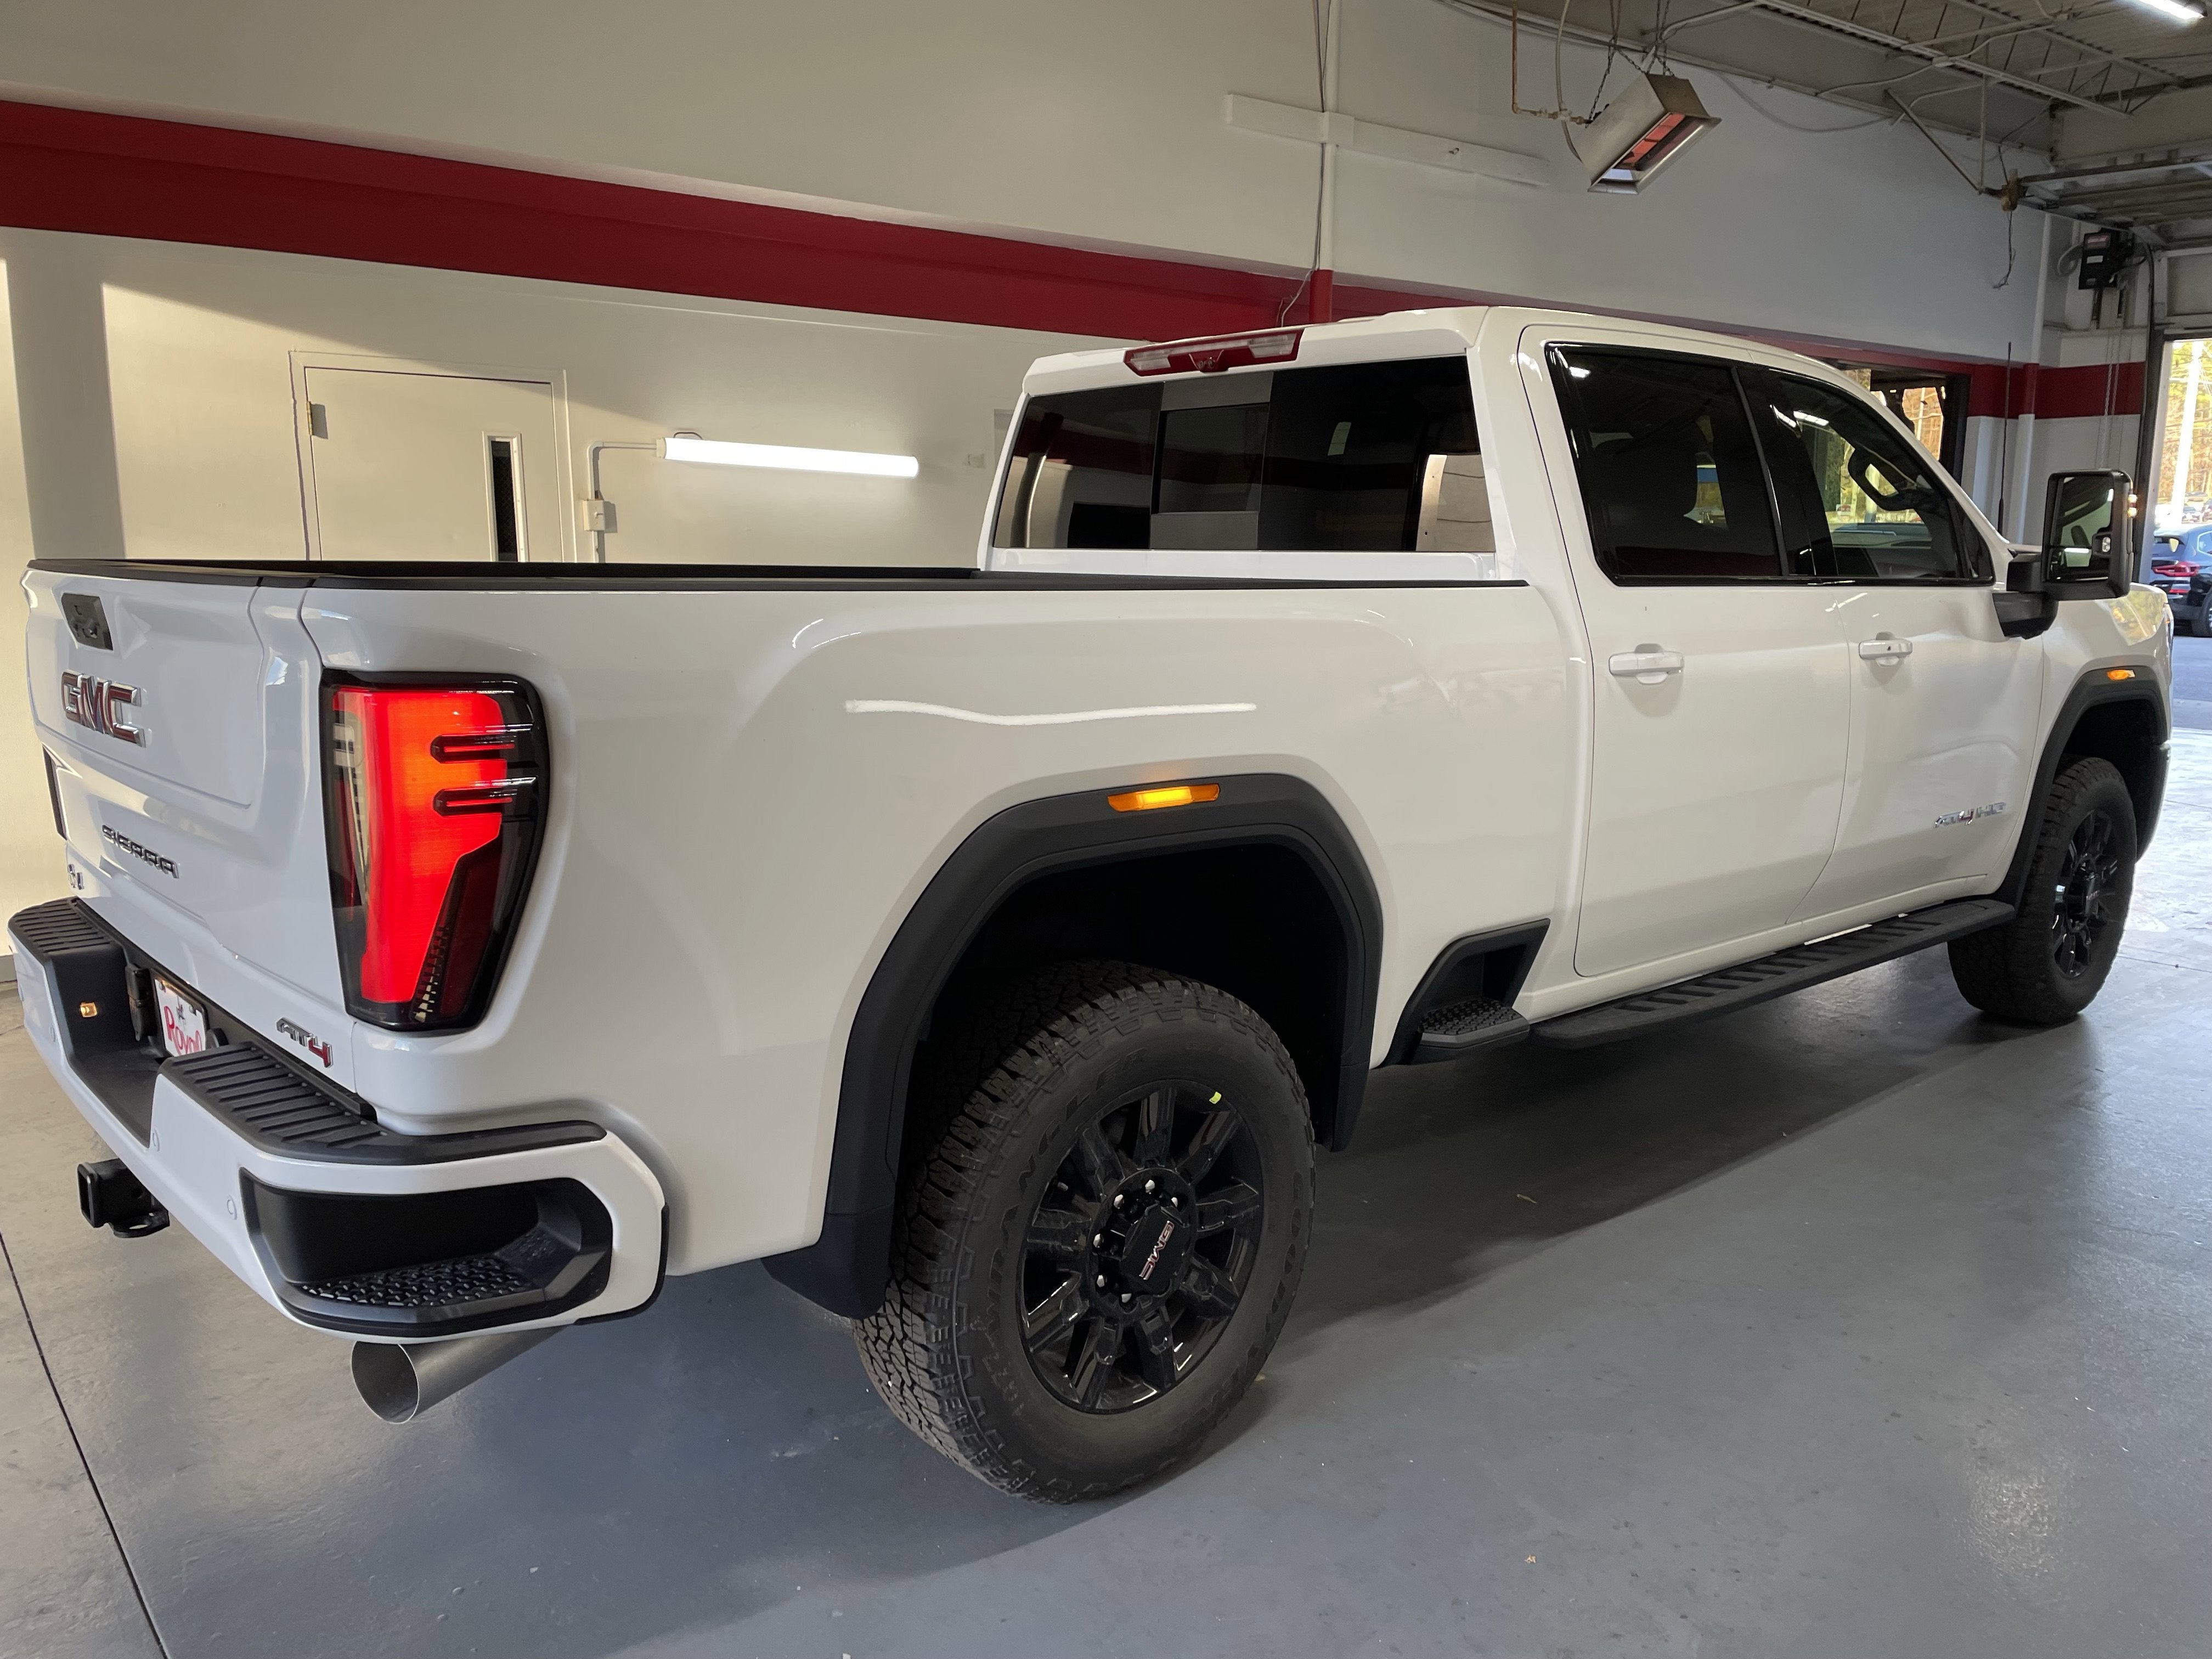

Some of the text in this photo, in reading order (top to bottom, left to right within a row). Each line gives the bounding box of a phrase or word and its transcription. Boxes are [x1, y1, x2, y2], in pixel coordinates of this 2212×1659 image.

[61, 669, 146, 747] GMC
[1933, 809, 1975, 828] AT4
[102, 825, 180, 879] SIERRA
[276, 1018, 334, 1068] AT4
[986, 1045, 1149, 1338] WRANGLER
[1138, 1220, 1175, 1280] GMC
